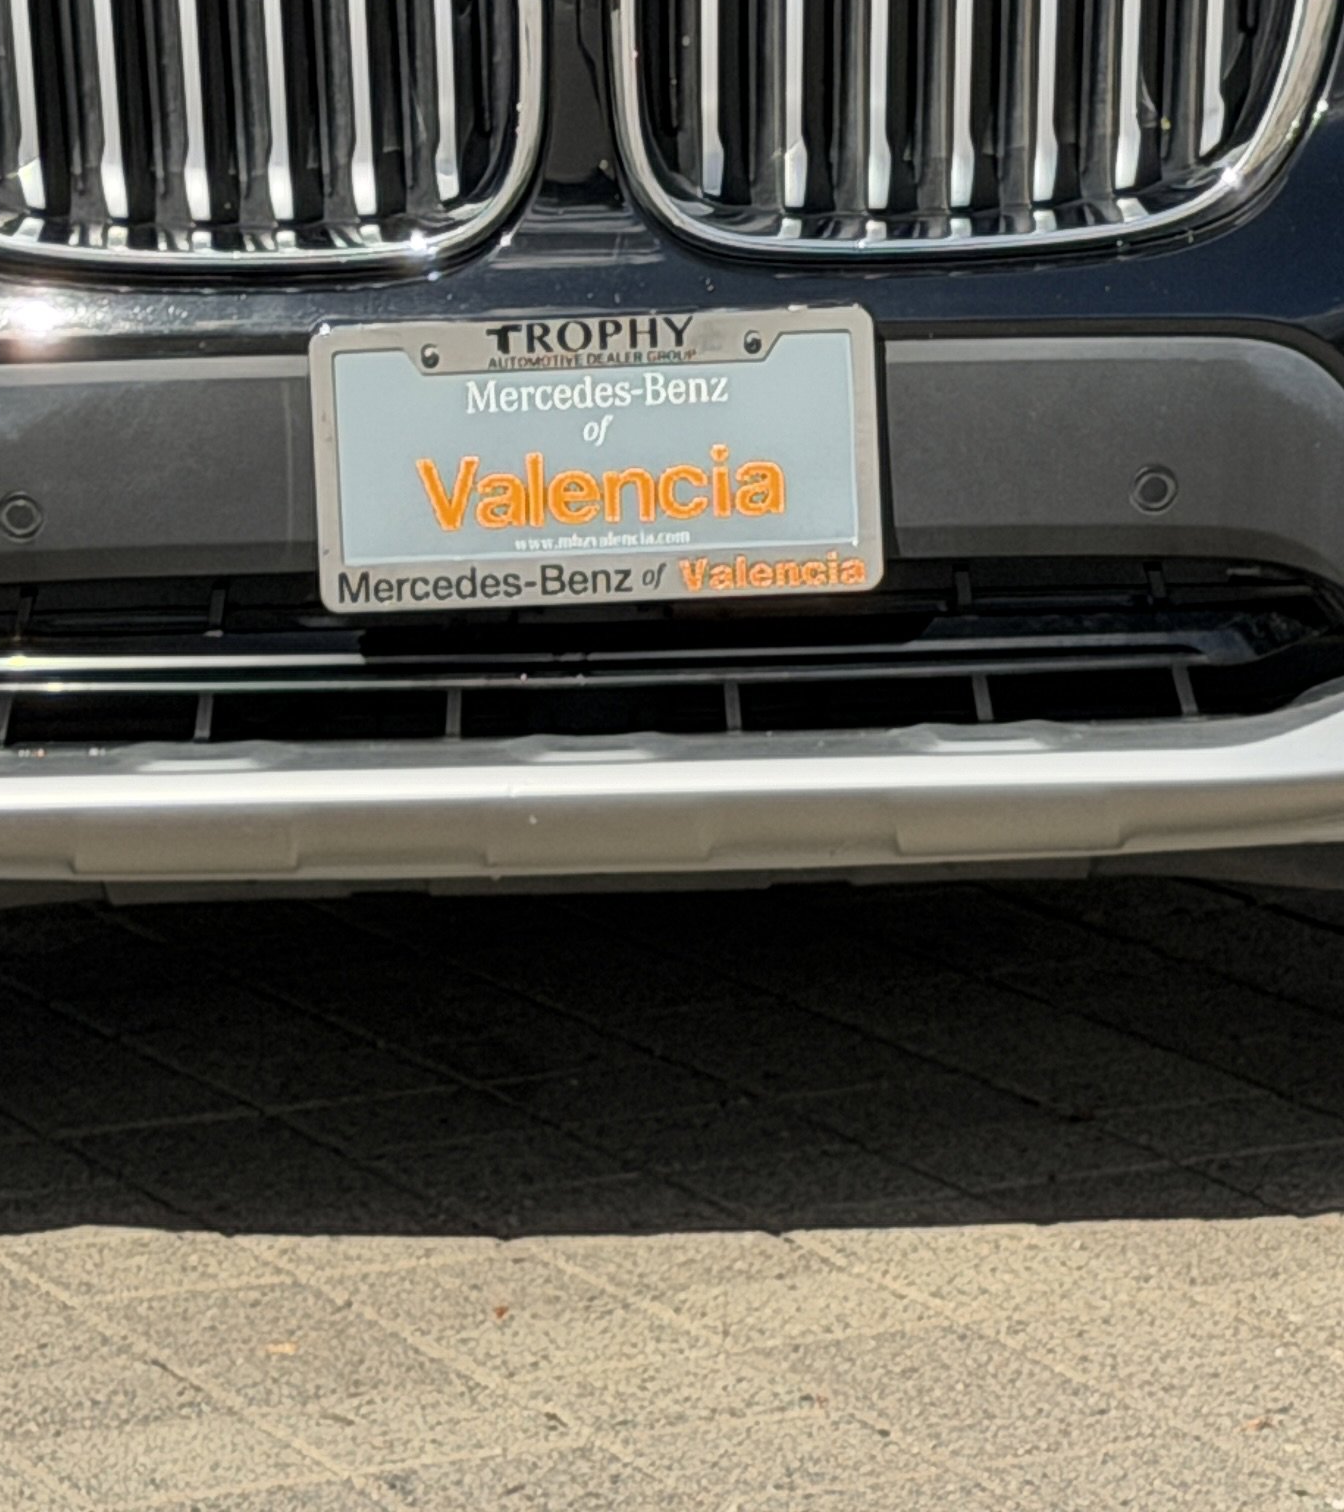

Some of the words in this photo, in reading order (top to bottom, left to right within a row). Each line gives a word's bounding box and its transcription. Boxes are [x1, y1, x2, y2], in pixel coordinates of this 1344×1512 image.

[485, 315, 694, 355] TROPHY
[488, 353, 581, 369] AUTOMOTIVE
[586, 351, 643, 365] DEALER
[647, 348, 697, 362] GROUP
[465, 373, 729, 414] Mercedes-Benz
[582, 414, 615, 447] of
[416, 443, 786, 532] Valencia
[337, 563, 634, 604] Mercedes-Benz
[641, 563, 667, 589] of
[678, 550, 867, 592] Valencia
